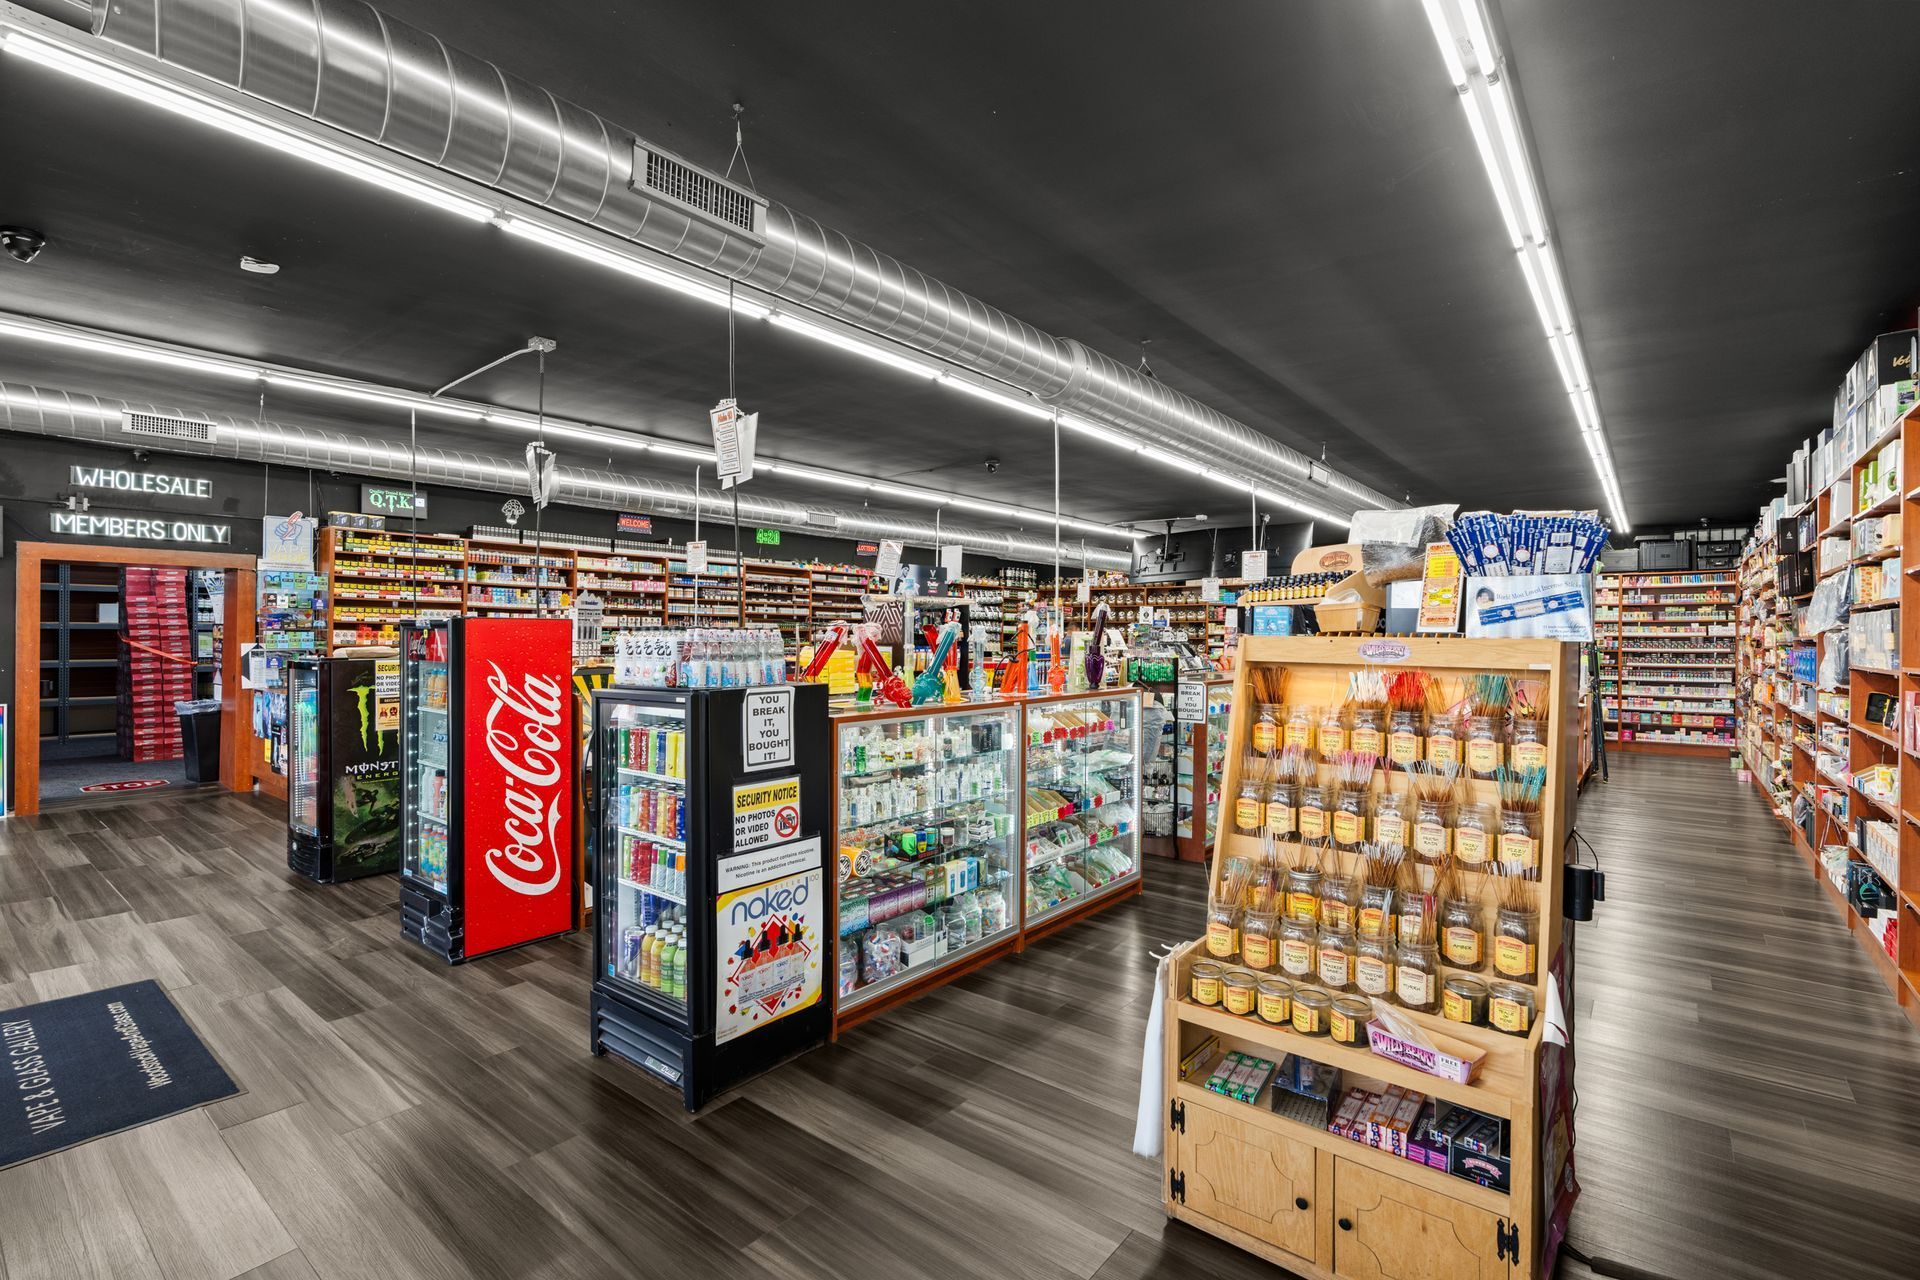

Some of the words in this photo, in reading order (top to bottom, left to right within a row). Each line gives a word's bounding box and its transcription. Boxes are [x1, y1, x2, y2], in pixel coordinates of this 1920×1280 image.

[75, 466, 209, 498] WHOLESALE
[55, 513, 166, 540] MEMBERS
[173, 522, 228, 544] ONLY
[620, 518, 649, 529] WELCOME
[756, 529, 780, 544] 4:20
[759, 696, 779, 704] YOU
[753, 706, 785, 716] BREAK
[764, 718, 775, 727] IT,
[760, 729, 779, 738] YOU
[749, 739, 790, 751] BOUGHT
[764, 752, 776, 761] IT!
[345, 760, 398, 775] MONST
[485, 659, 562, 896] Coca-Cola
[88, 780, 162, 792] STOP
[736, 790, 772, 808] SECURITY
[773, 786, 797, 802] NOTICE
[735, 814, 746, 824] NO
[748, 809, 776, 822] PHOTOS
[735, 827, 746, 836] OR
[747, 822, 769, 834] VIDEO
[735, 834, 769, 848] ALLOWED
[725, 863, 750, 873] WARNING:
[762, 856, 779, 865] product
[780, 852, 798, 860] contains
[735, 869, 755, 879] Nicotine
[767, 863, 787, 871] addictive
[731, 877, 808, 926] naked
[1, 1019, 40, 1056] GALLERY
[1374, 1032, 1403, 1052] WILD
[1403, 1043, 1436, 1067] BERRY
[12, 1055, 51, 1090] GLASS
[23, 1087, 56, 1101] &
[25, 1098, 66, 1135] VAPE
